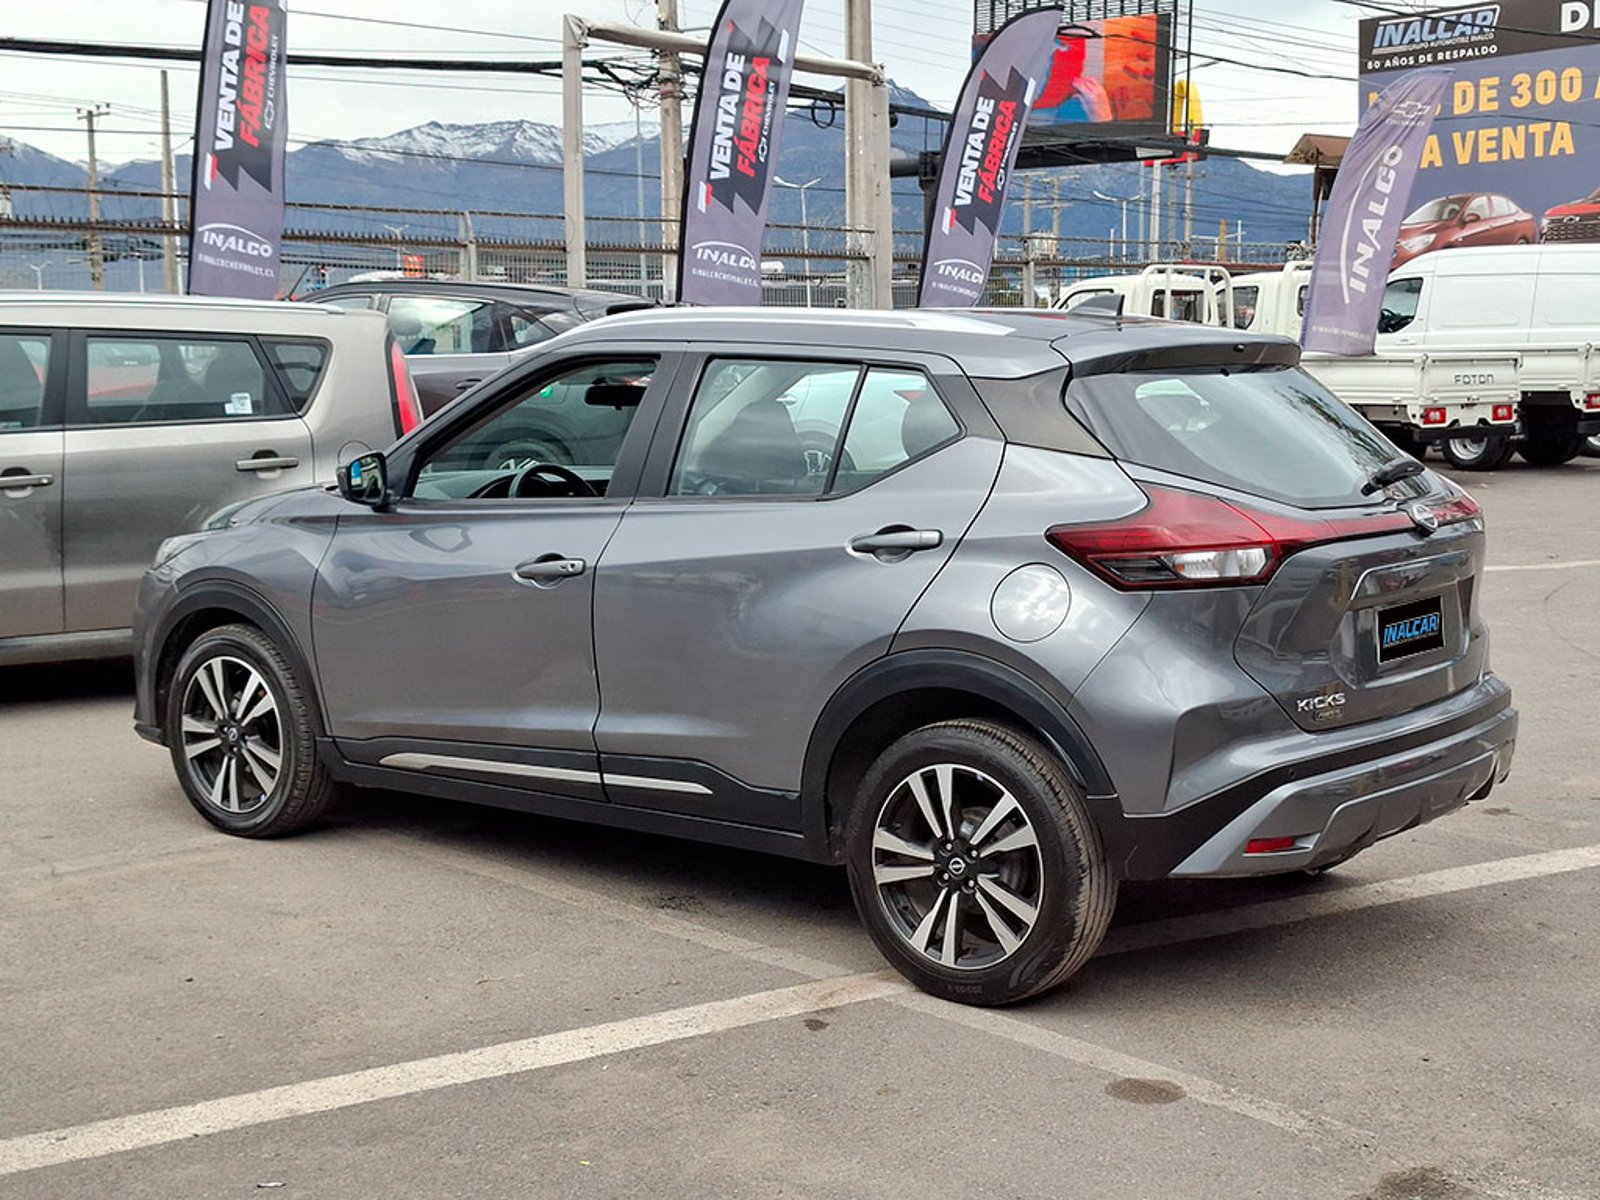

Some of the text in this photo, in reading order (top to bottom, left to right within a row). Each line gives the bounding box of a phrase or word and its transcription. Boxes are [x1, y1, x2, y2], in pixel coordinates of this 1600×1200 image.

[1374, 10, 1495, 47] INALCAR
[1560, 1, 1600, 33] D
[214, 0, 245, 150] VENTA DE
[236, 5, 270, 148] FÁBRICA
[266, 34, 279, 98] CHEVROLET
[1384, 54, 1415, 68] AÑOS
[1418, 52, 1433, 63] DE
[1437, 44, 1498, 60] RESPALDO
[1453, 76, 1500, 115] DE
[1510, 66, 1583, 108] 300
[710, 52, 746, 180] VENTA DE
[733, 56, 771, 177] FÁBRICA
[954, 96, 995, 206] VENTA DE
[978, 100, 1017, 204] FÁBRICA
[1452, 122, 1575, 165] VENTA
[1350, 145, 1403, 294] INALCO
[203, 231, 273, 258] INALCO
[1454, 374, 1495, 385] FOTON
[1383, 613, 1438, 643] INALCAR
[1297, 693, 1347, 711] KICKS
